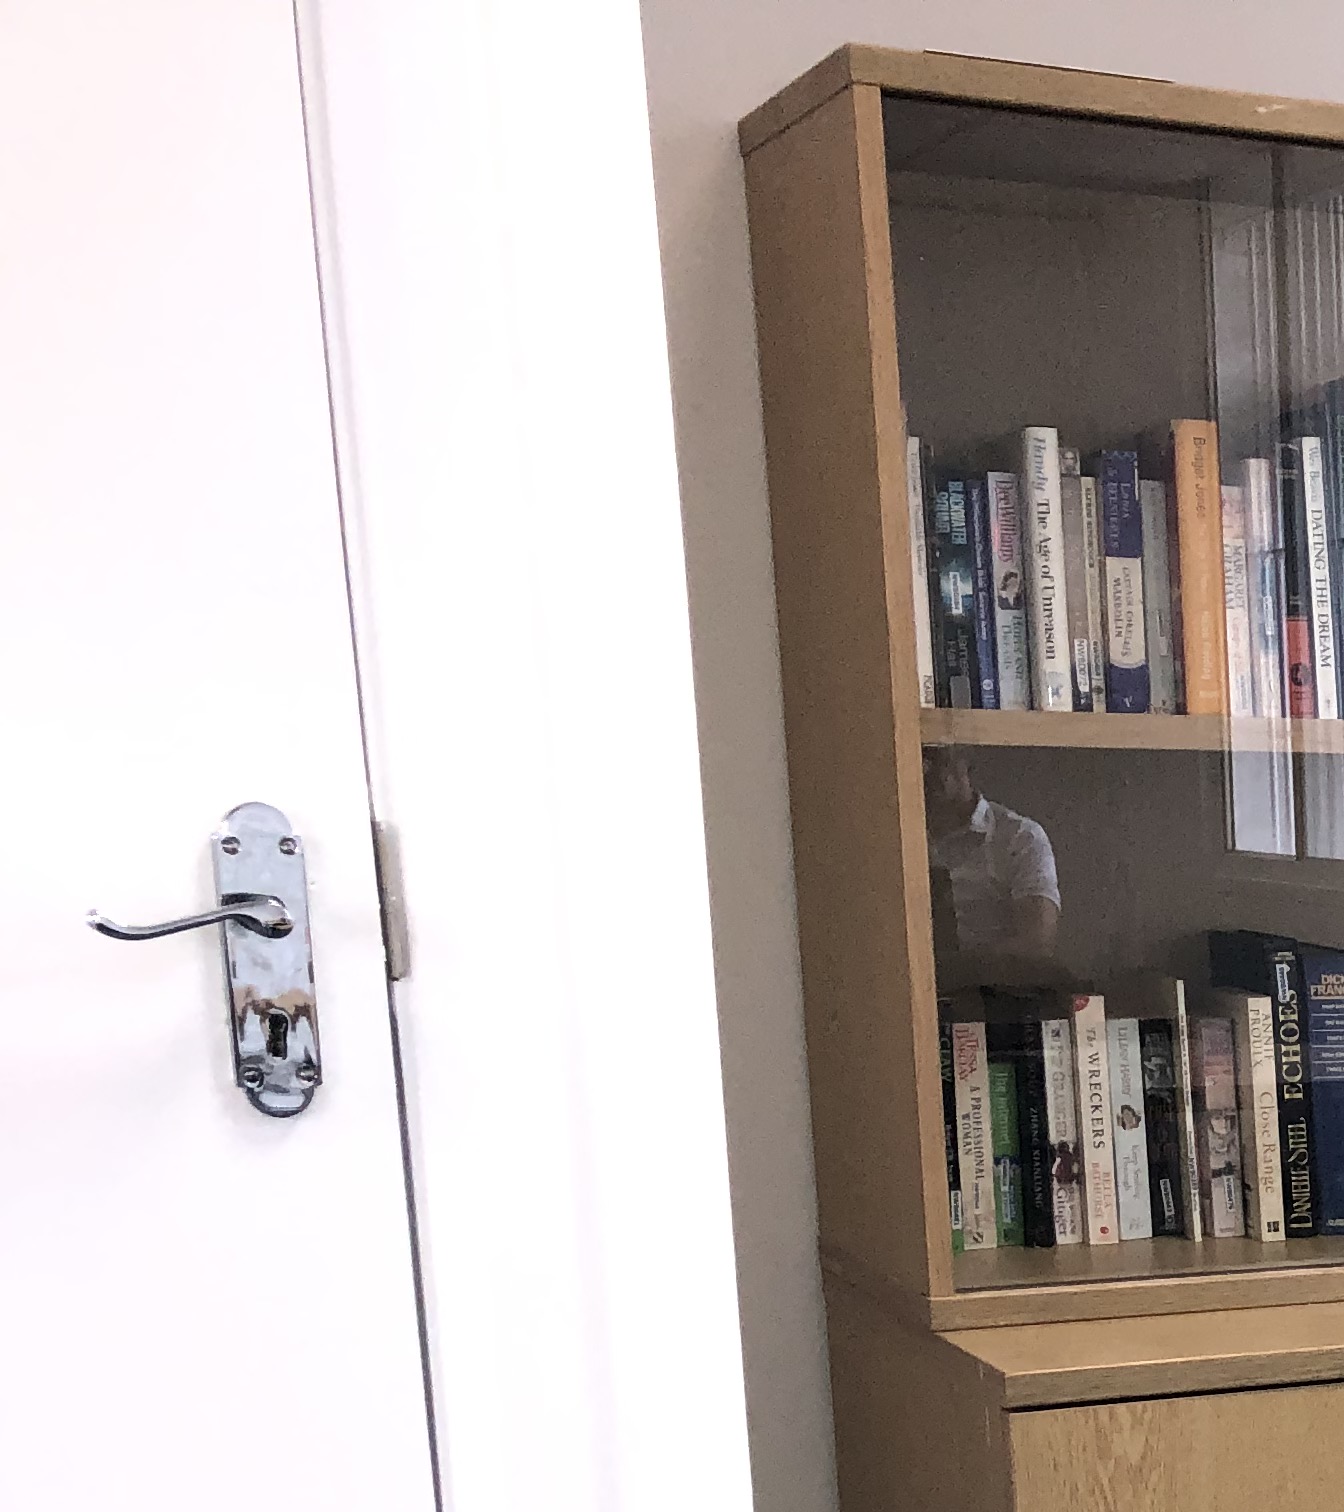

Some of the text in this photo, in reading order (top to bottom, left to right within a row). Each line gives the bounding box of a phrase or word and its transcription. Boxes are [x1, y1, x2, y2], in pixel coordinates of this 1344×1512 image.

[1191, 436, 1207, 518] Bridget Jones
[948, 481, 967, 544] BLACKWATER
[1033, 436, 1058, 660] Handy The Age of Unreason
[1233, 544, 1244, 611] MARGARET
[1310, 509, 1332, 668] DATING THE DREAM
[1249, 1009, 1263, 1068] PROULX
[1262, 1013, 1274, 1061] ANNIE
[1277, 990, 1304, 1100] ECHOES
[1085, 1028, 1105, 1150] The WRECKERS
[962, 1112, 971, 1156] WOMAN
[970, 1097, 985, 1180] PROFESSIONAL
[996, 1097, 1010, 1146] Internet
[1029, 1107, 1039, 1145] ZHANG
[1259, 1091, 1277, 1195] Close Range
[1287, 1118, 1309, 1164] STEEL
[1053, 1187, 1068, 1236] Ginger
[1290, 1166, 1313, 1228] DANIELLE
